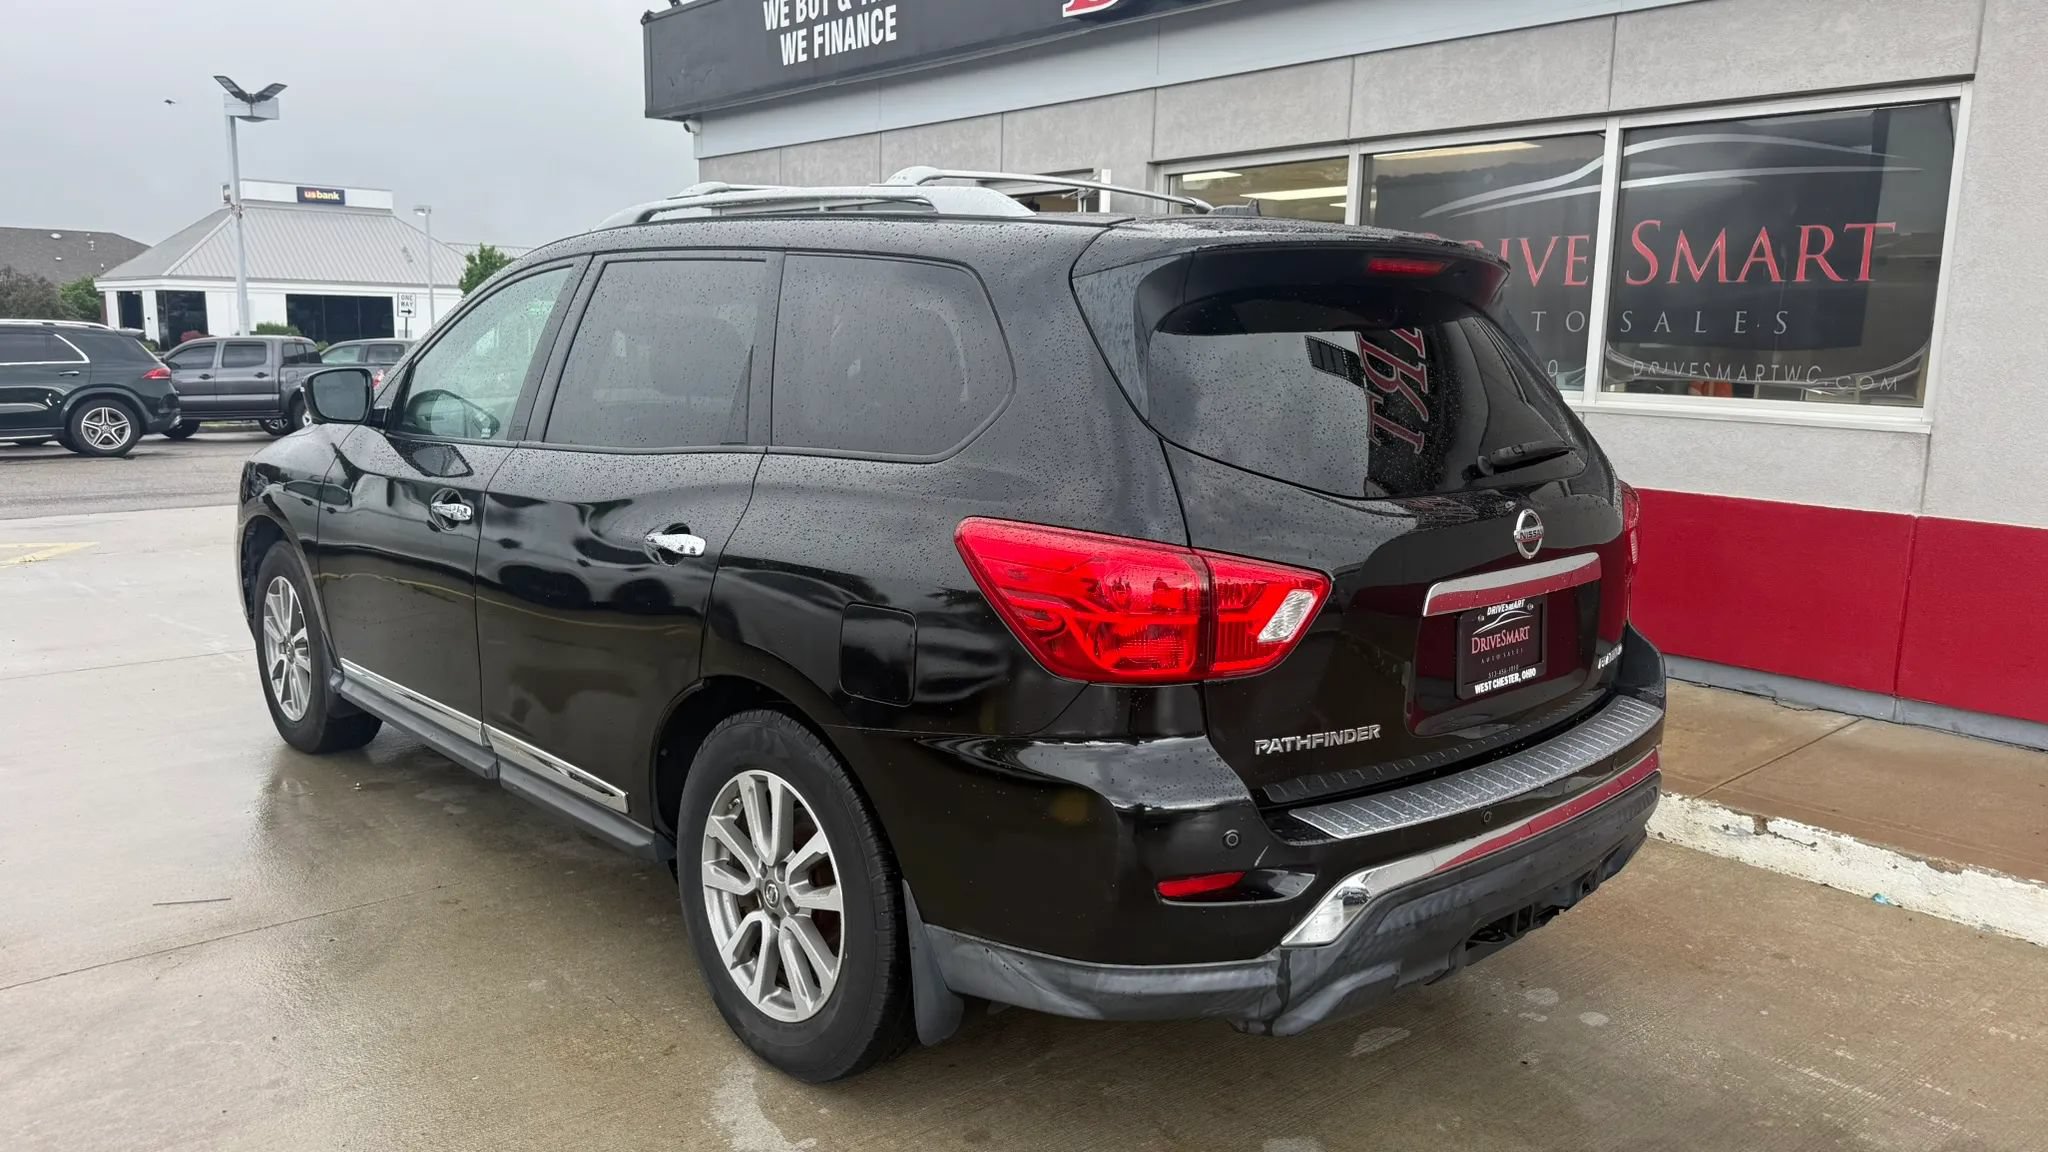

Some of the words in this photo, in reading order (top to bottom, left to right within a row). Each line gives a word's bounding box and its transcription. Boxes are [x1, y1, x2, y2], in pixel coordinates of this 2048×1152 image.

[780, 28, 807, 66] WE
[813, 4, 897, 59] FINANCE
[1487, 599, 1525, 616] DRIVESMART
[1474, 681, 1492, 694] WEST
[1521, 667, 1537, 680] OHIO
[1254, 724, 1381, 755] PATHFINDER
